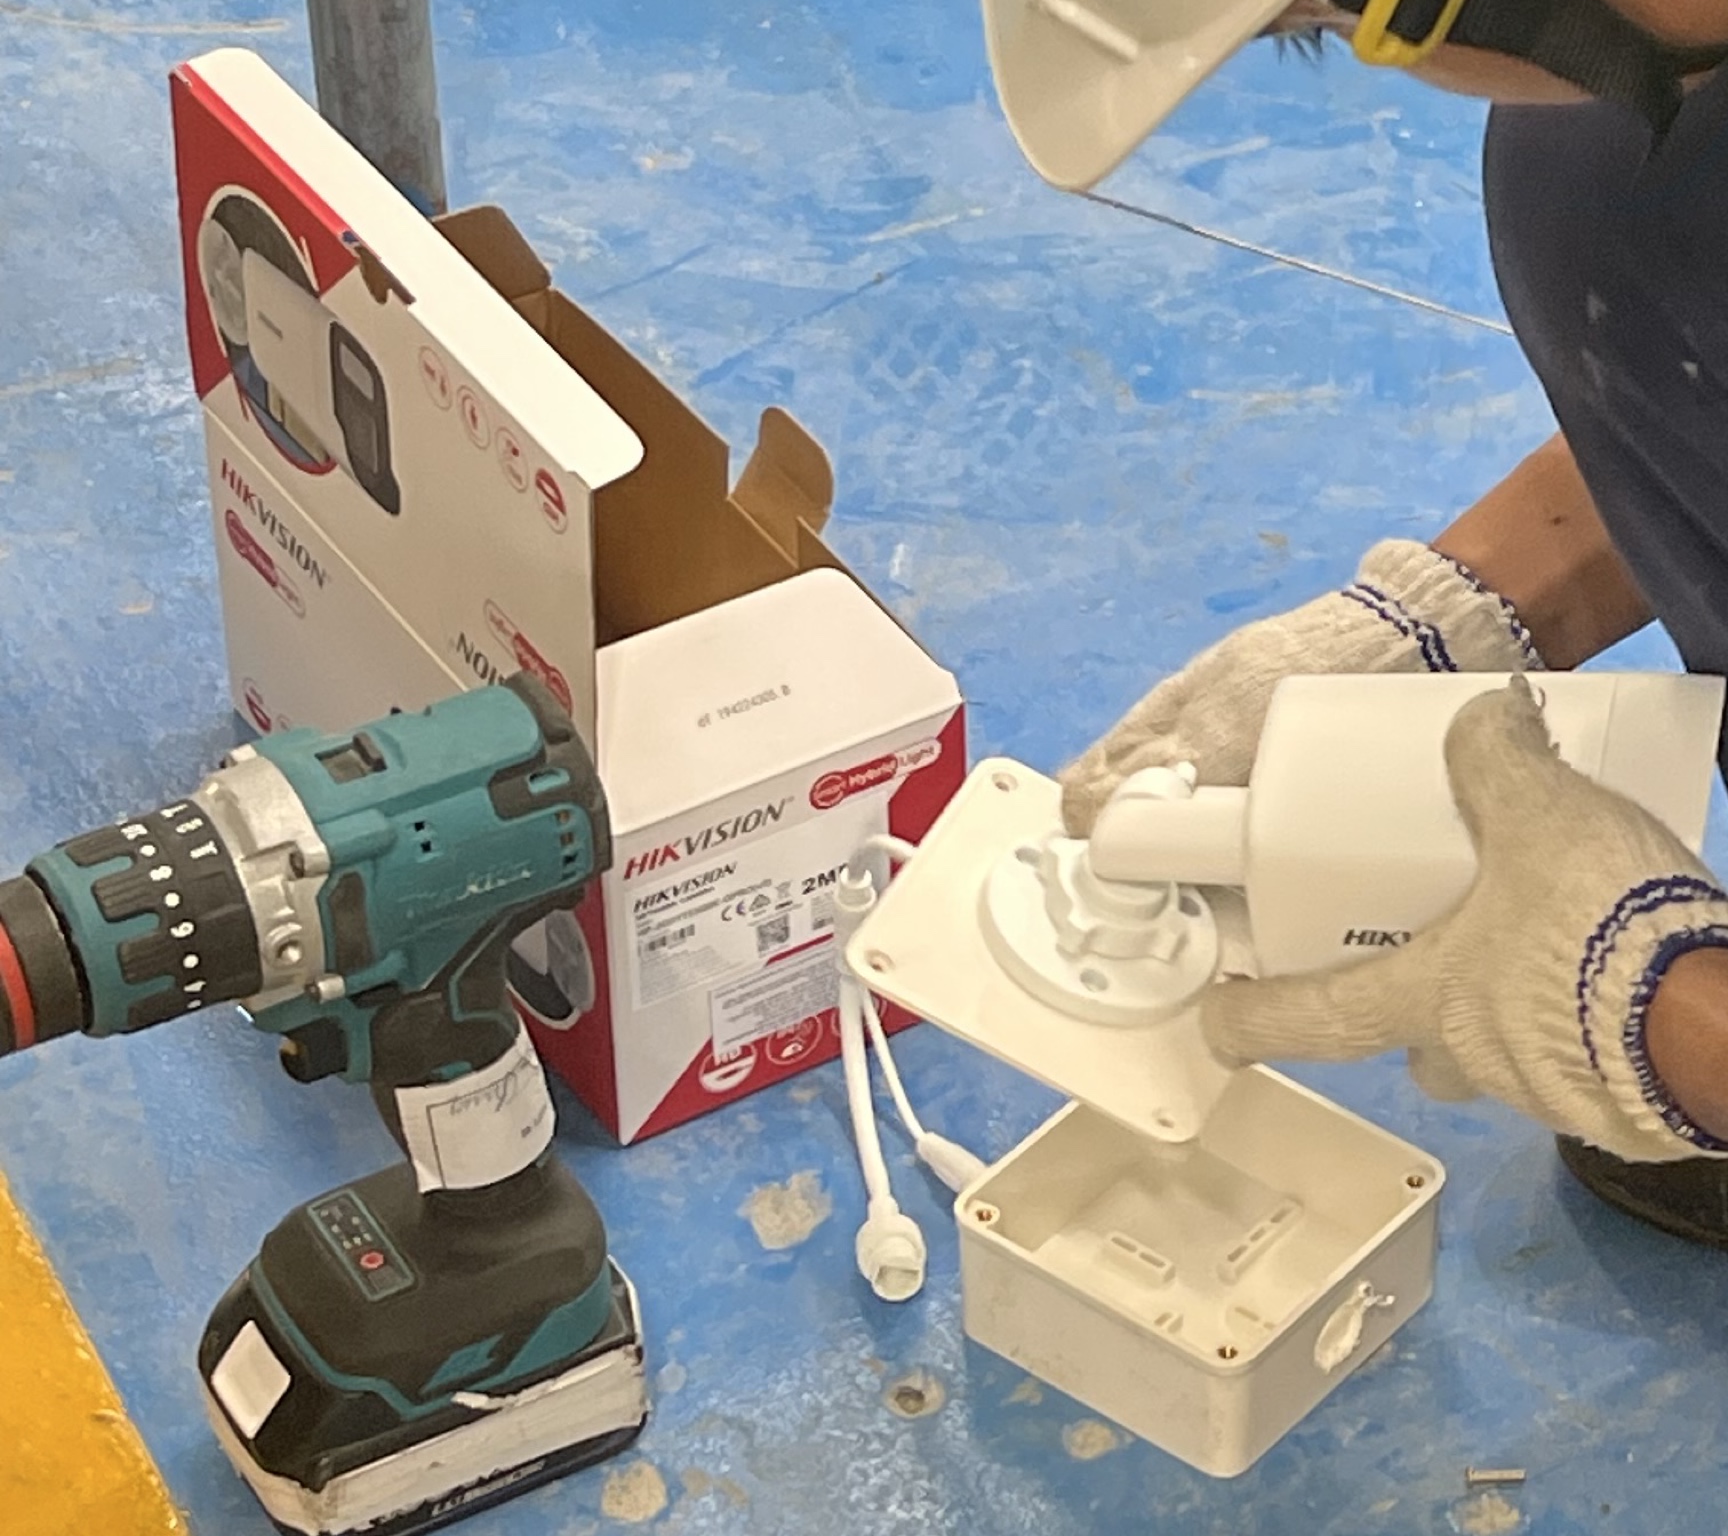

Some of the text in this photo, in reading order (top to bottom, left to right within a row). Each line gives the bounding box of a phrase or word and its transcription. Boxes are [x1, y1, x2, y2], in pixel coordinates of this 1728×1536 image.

[221, 459, 328, 589] HIKVISION
[623, 798, 788, 880] HIKVISION
[633, 861, 738, 914] HIKVISION
